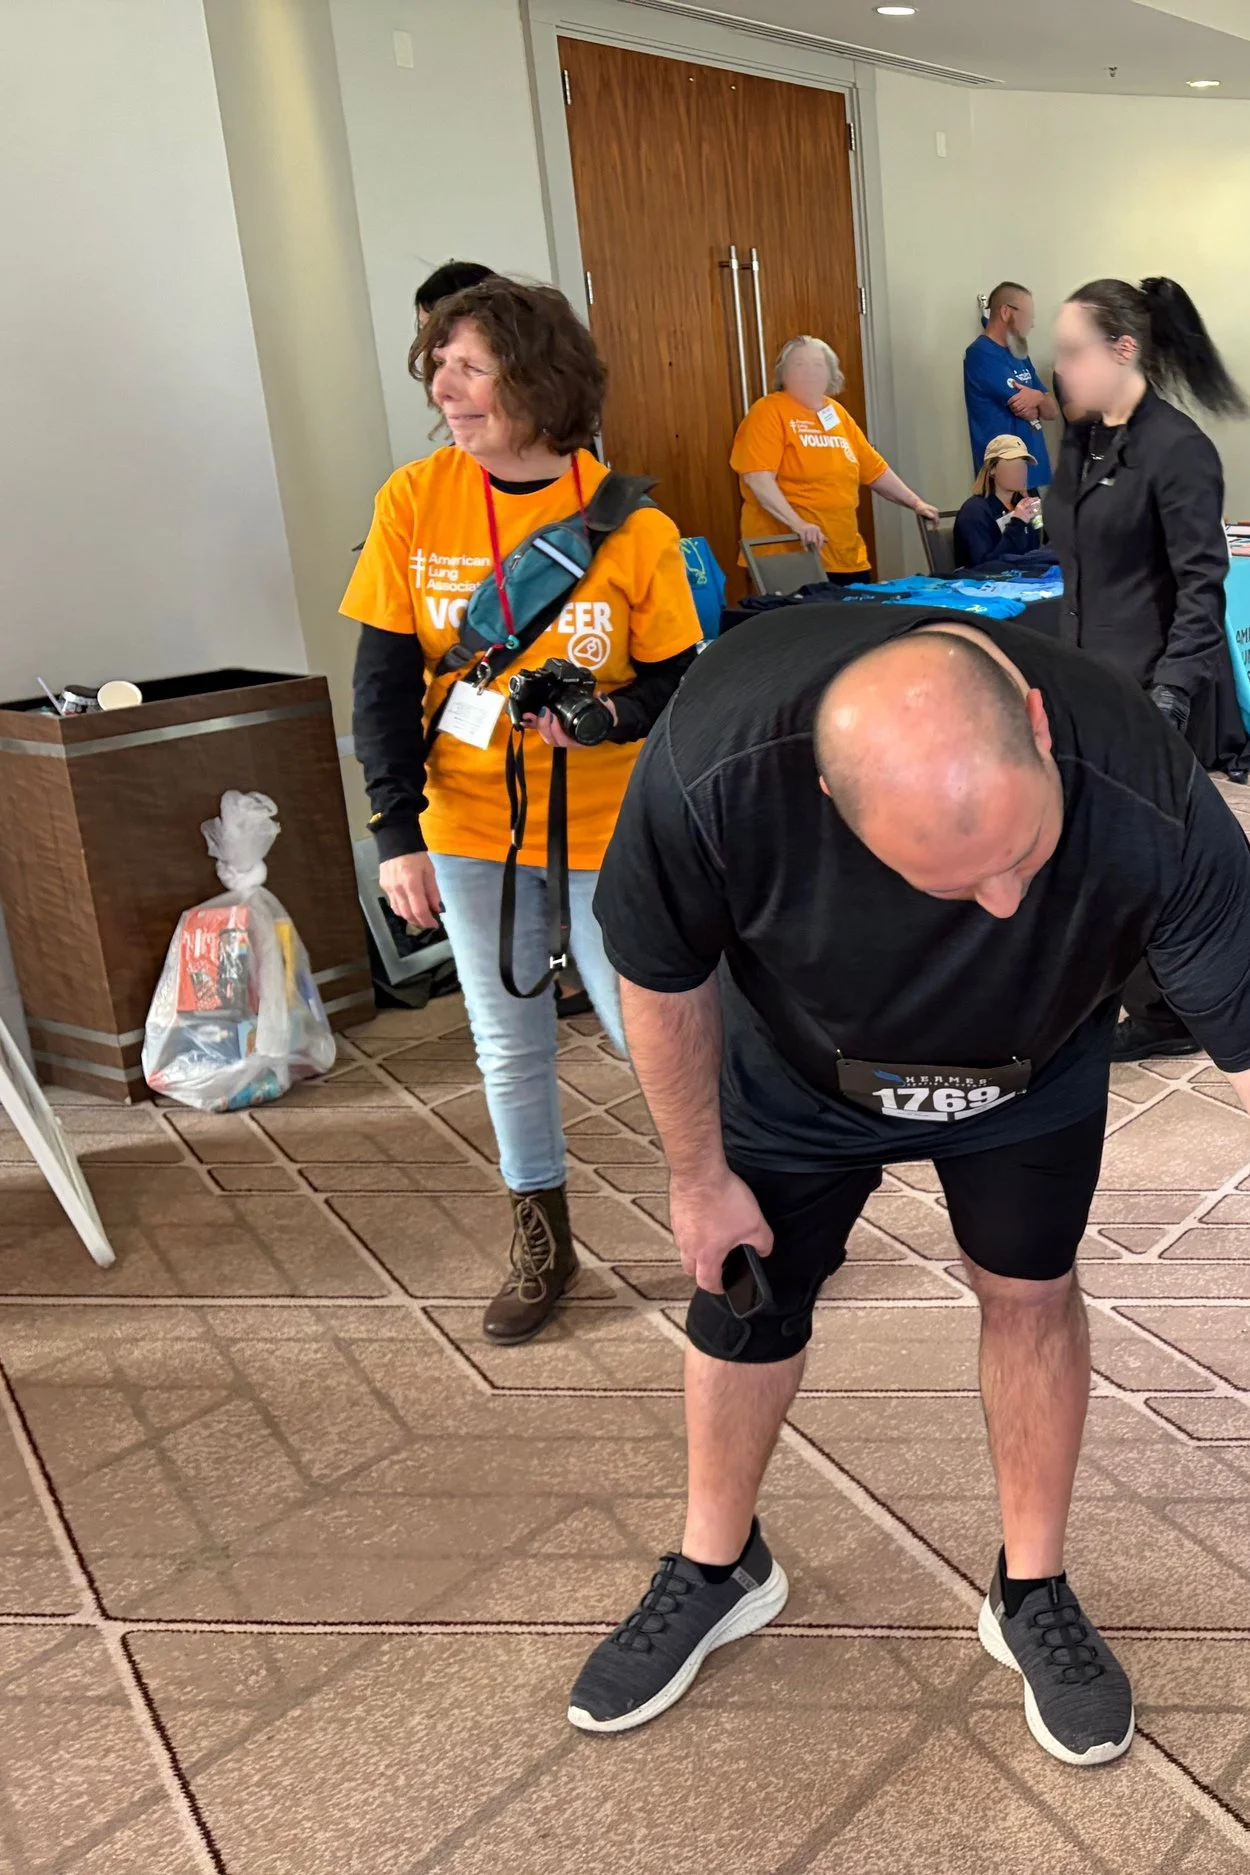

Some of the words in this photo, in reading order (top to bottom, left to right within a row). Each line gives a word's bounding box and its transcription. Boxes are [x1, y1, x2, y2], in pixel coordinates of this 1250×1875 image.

[428, 552, 491, 566] American
[428, 565, 459, 582] Lung
[426, 578, 480, 592] Associat
[425, 596, 614, 634] VOEER
[872, 1086, 1001, 1112] 1769
